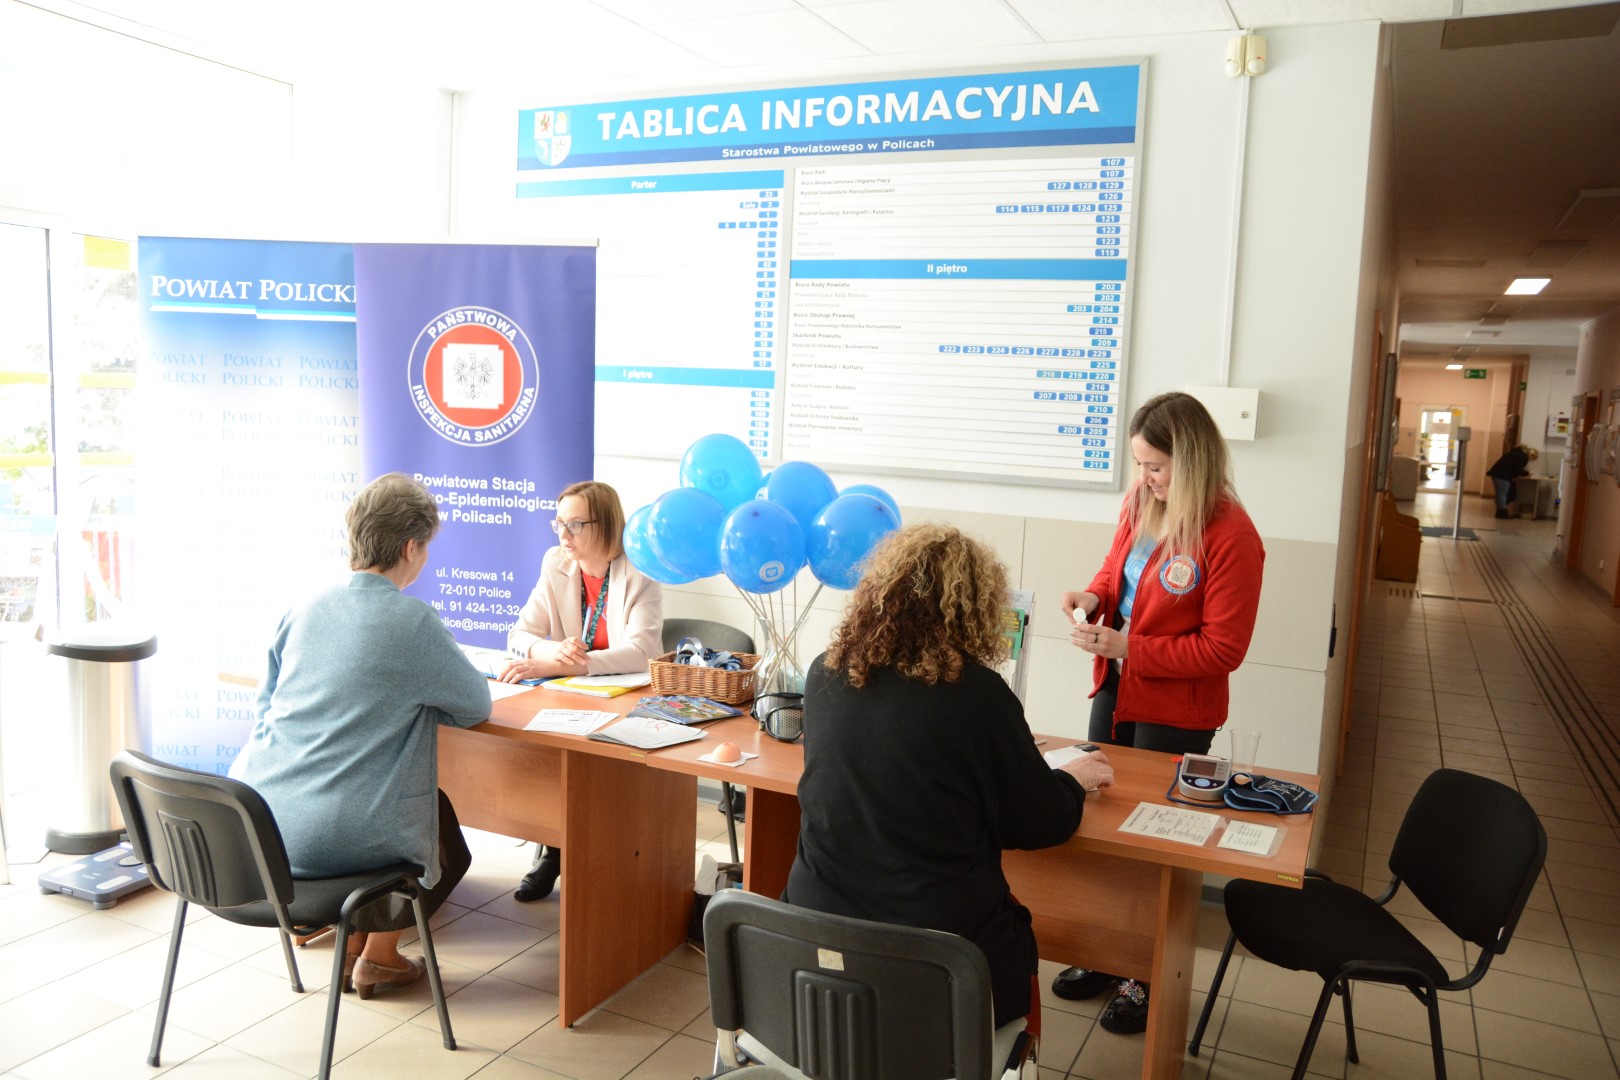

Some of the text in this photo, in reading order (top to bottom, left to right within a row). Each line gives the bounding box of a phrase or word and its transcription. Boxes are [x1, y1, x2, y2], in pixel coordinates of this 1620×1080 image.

[597, 80, 1100, 141] TABLICA INFORMACYJNA
[722, 146, 780, 158] Starostwa
[783, 142, 864, 156] Powiatowego
[882, 138, 935, 150] Policach
[631, 179, 657, 190] Parter
[926, 263, 968, 276] II piętro
[150, 275, 252, 299] POWIAT
[427, 310, 517, 342] PAŃSTWOWA
[991, 346, 1005, 354] 224
[412, 384, 471, 441] INSPEKCJA
[475, 387, 535, 442] SANITARNA
[413, 473, 535, 494] Powiatowa Stacja
[437, 509, 512, 525] w Policach
[436, 567, 514, 582] ul. Kresowa 14
[439, 583, 512, 598] 72-010 Police
[431, 599, 520, 616] tel. 91 424-12-32
